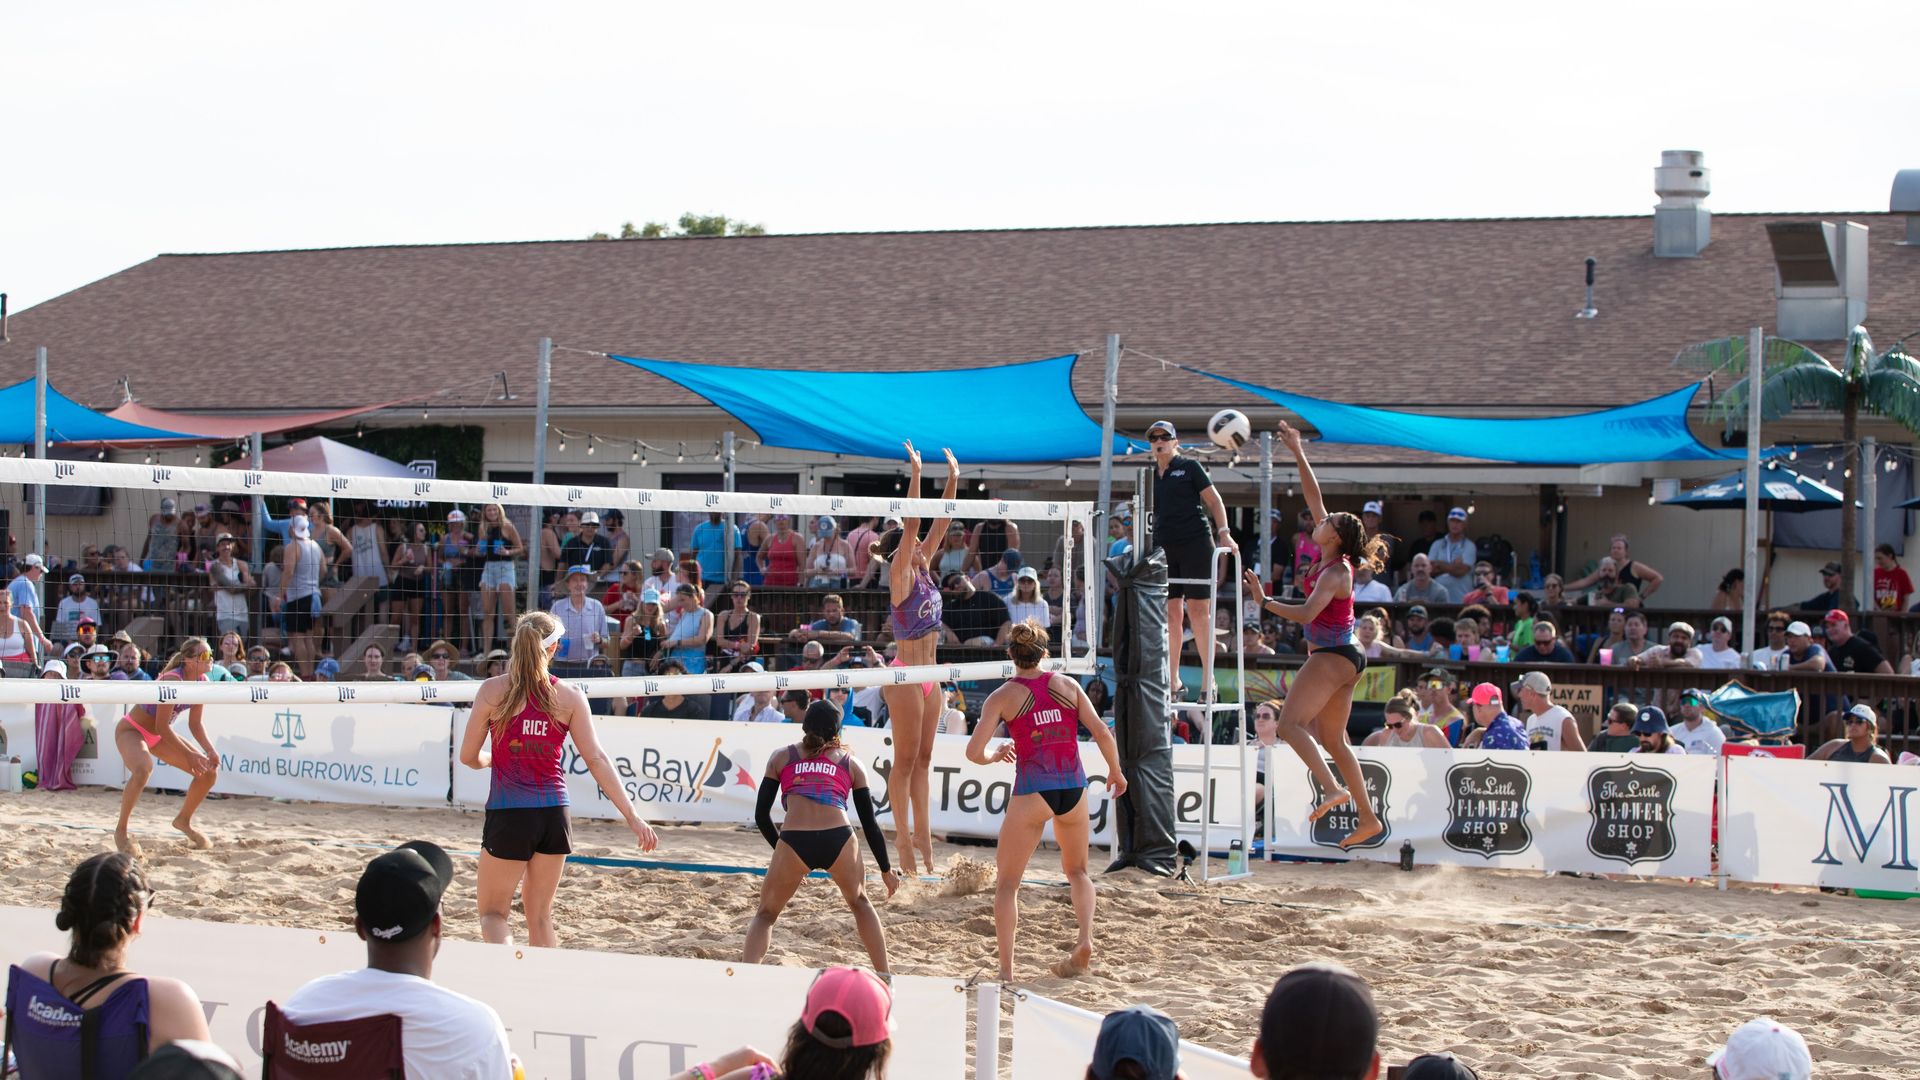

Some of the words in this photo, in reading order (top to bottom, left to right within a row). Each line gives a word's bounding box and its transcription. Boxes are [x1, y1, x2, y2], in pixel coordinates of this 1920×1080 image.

[54, 462, 75, 479] Lite
[152, 469, 171, 484] Lite
[244, 473, 261, 488] Lite
[331, 478, 348, 492] Lite
[414, 482, 430, 496] Lite
[492, 485, 508, 498] Lite
[568, 487, 582, 501] Lite
[638, 491, 652, 505] Lite
[706, 493, 719, 507] Lite
[644, 680, 658, 695] Lite
[712, 678, 725, 692] Lite
[775, 675, 788, 690] Lite
[61, 684, 80, 702] Lite
[158, 686, 177, 703] Lite
[251, 687, 268, 703] Lite
[338, 686, 355, 702] Lite
[421, 687, 437, 700] Lite
[1551, 688, 1575, 700] LAY
[1577, 689, 1591, 701] AT
[1033, 709, 1062, 726] LLOYD
[522, 719, 548, 736] RICE
[239, 757, 271, 776] and
[276, 758, 377, 786] BURROWS,
[383, 766, 419, 787] LLC
[642, 748, 704, 802] Bay
[795, 762, 837, 776] URANGO
[1459, 777, 1482, 795] The
[1482, 776, 1516, 796] Little
[1600, 781, 1624, 800] The
[1625, 780, 1660, 798] Little
[1329, 816, 1359, 830] SHO
[1462, 821, 1509, 835] SHOP
[1607, 824, 1655, 839] SHOP
[284, 1032, 348, 1060] Academy
